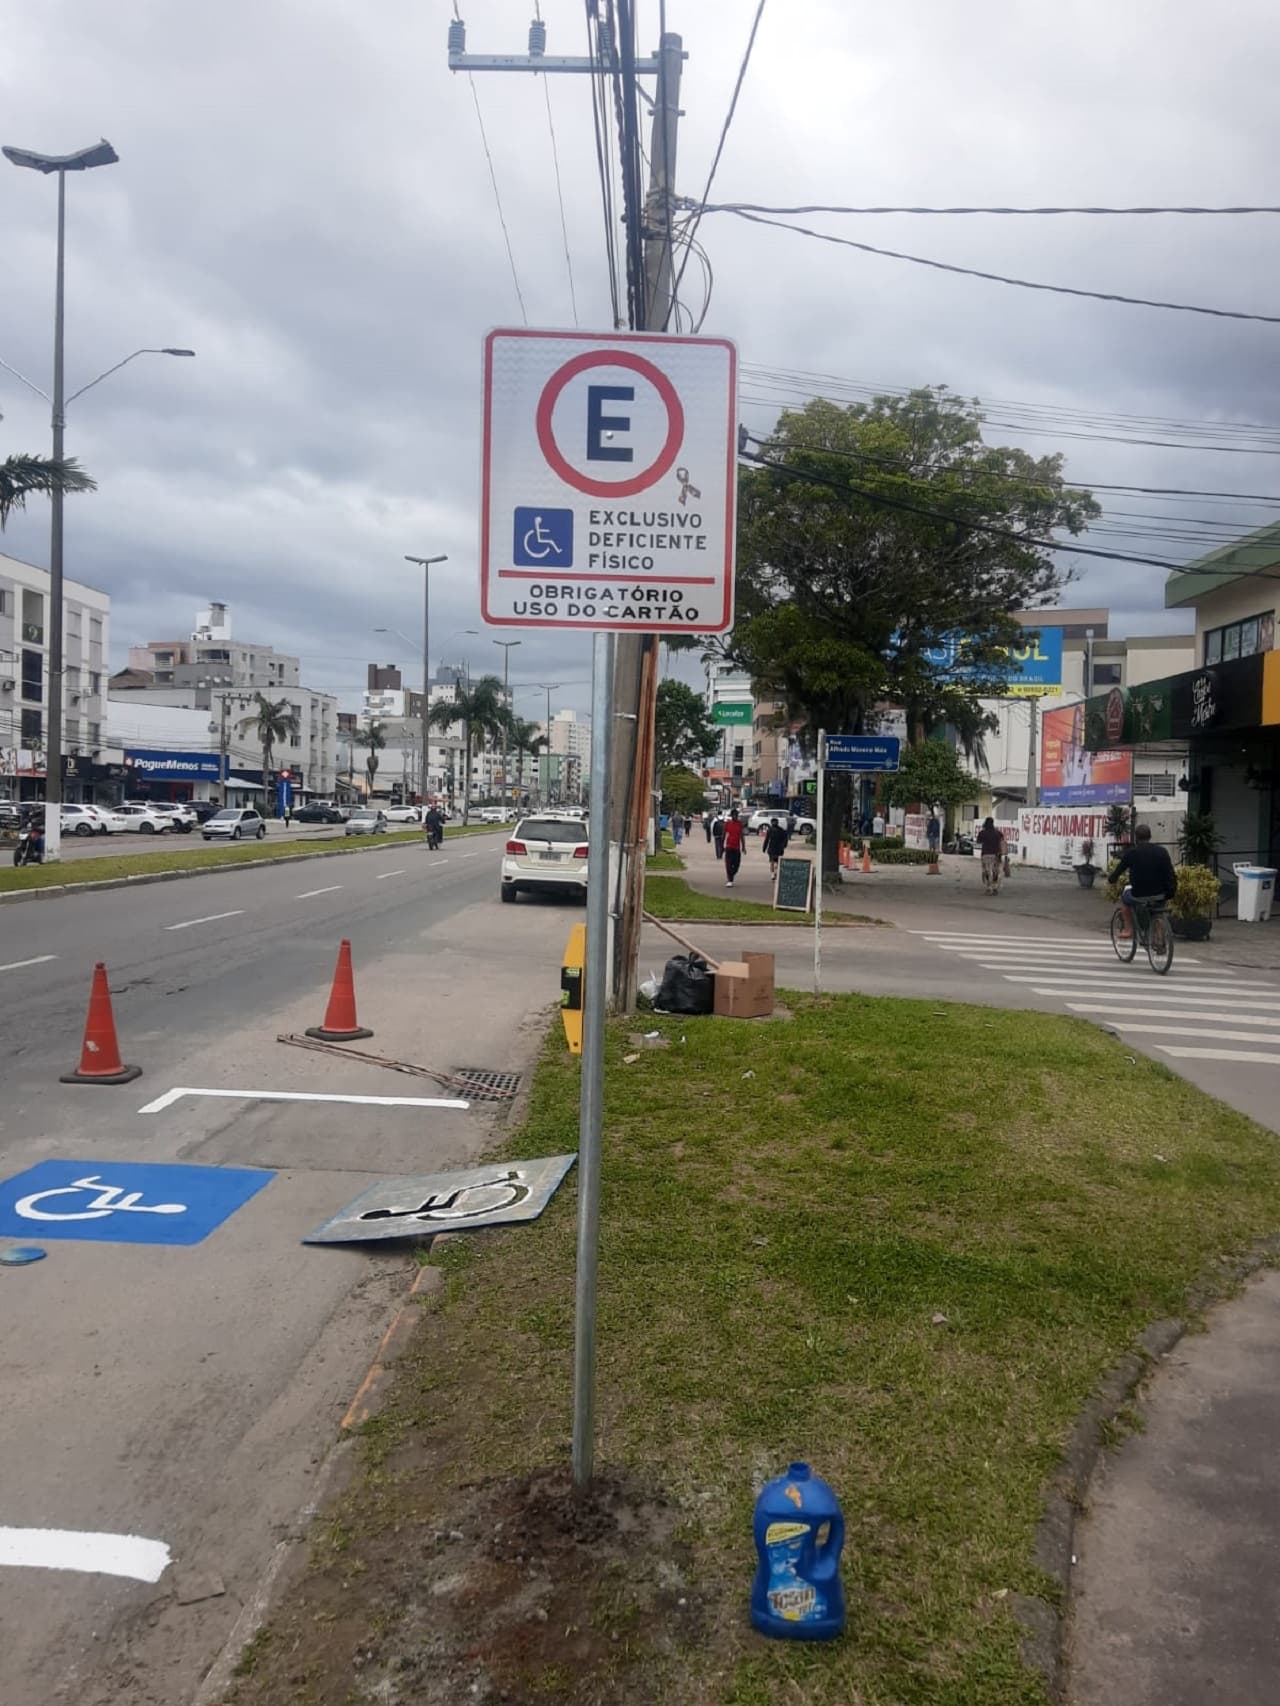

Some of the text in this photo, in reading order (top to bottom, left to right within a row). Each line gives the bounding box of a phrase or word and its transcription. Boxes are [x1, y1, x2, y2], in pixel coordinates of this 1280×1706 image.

[587, 385, 635, 462] E
[589, 510, 703, 529] EXCLUSIVO
[588, 532, 707, 550] DEFICIENTE
[588, 551, 655, 570] FÍSICO
[529, 583, 684, 603] OBRIGATÓRIO
[513, 601, 699, 621] USO DO CARTÃO
